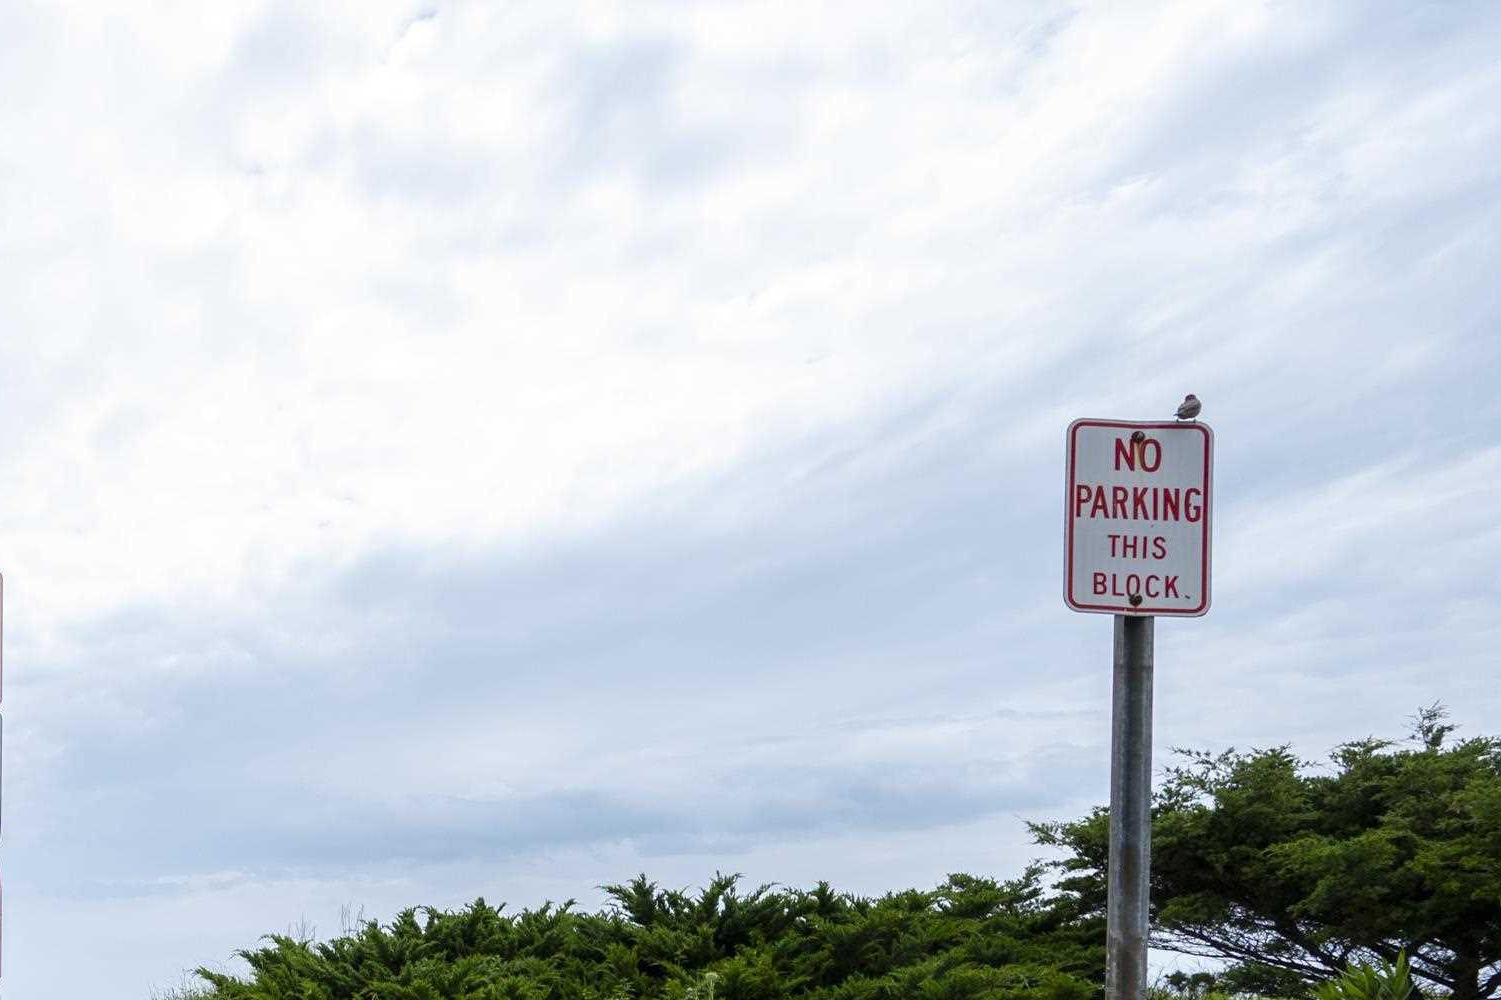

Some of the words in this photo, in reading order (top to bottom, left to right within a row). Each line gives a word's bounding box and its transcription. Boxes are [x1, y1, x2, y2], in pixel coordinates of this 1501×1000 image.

[1114, 437, 1162, 473] NO
[1076, 484, 1203, 523] PARKING
[1108, 534, 1167, 560] THIS
